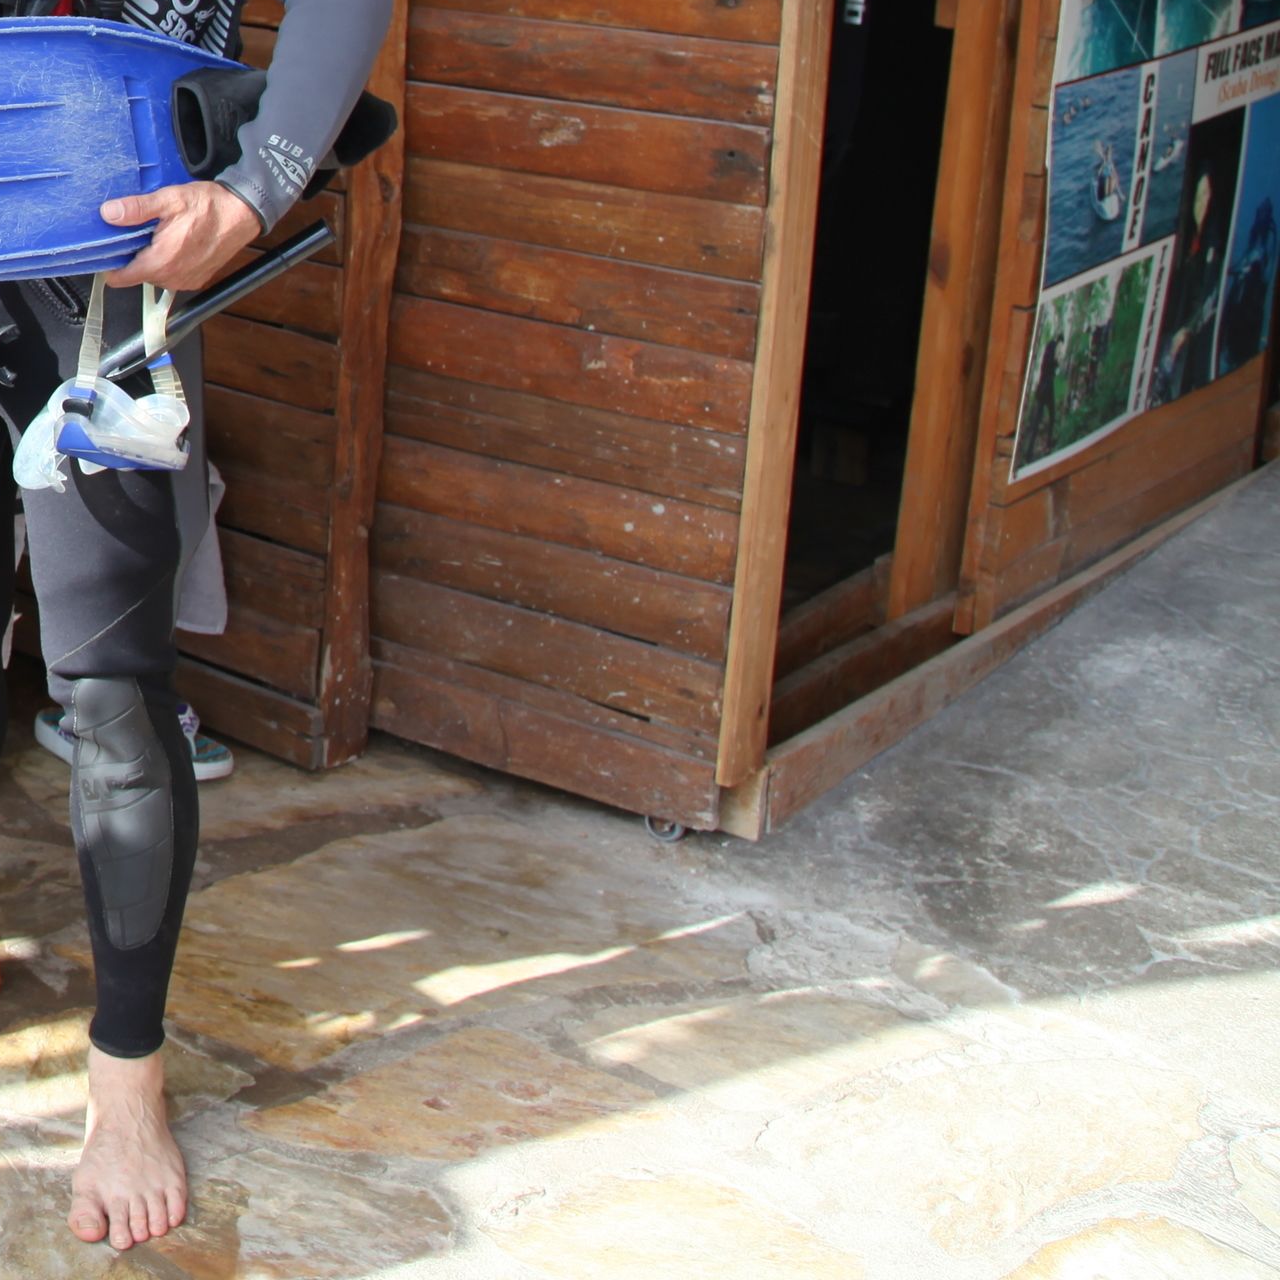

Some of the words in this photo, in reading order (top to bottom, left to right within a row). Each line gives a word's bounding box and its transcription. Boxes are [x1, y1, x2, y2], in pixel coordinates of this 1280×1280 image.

[1205, 46, 1231, 83] FULL
[1232, 35, 1264, 73] FACE
[258, 147, 286, 186] WARM
[268, 134, 304, 158] SUB
[1128, 73, 1155, 240] CANOE
